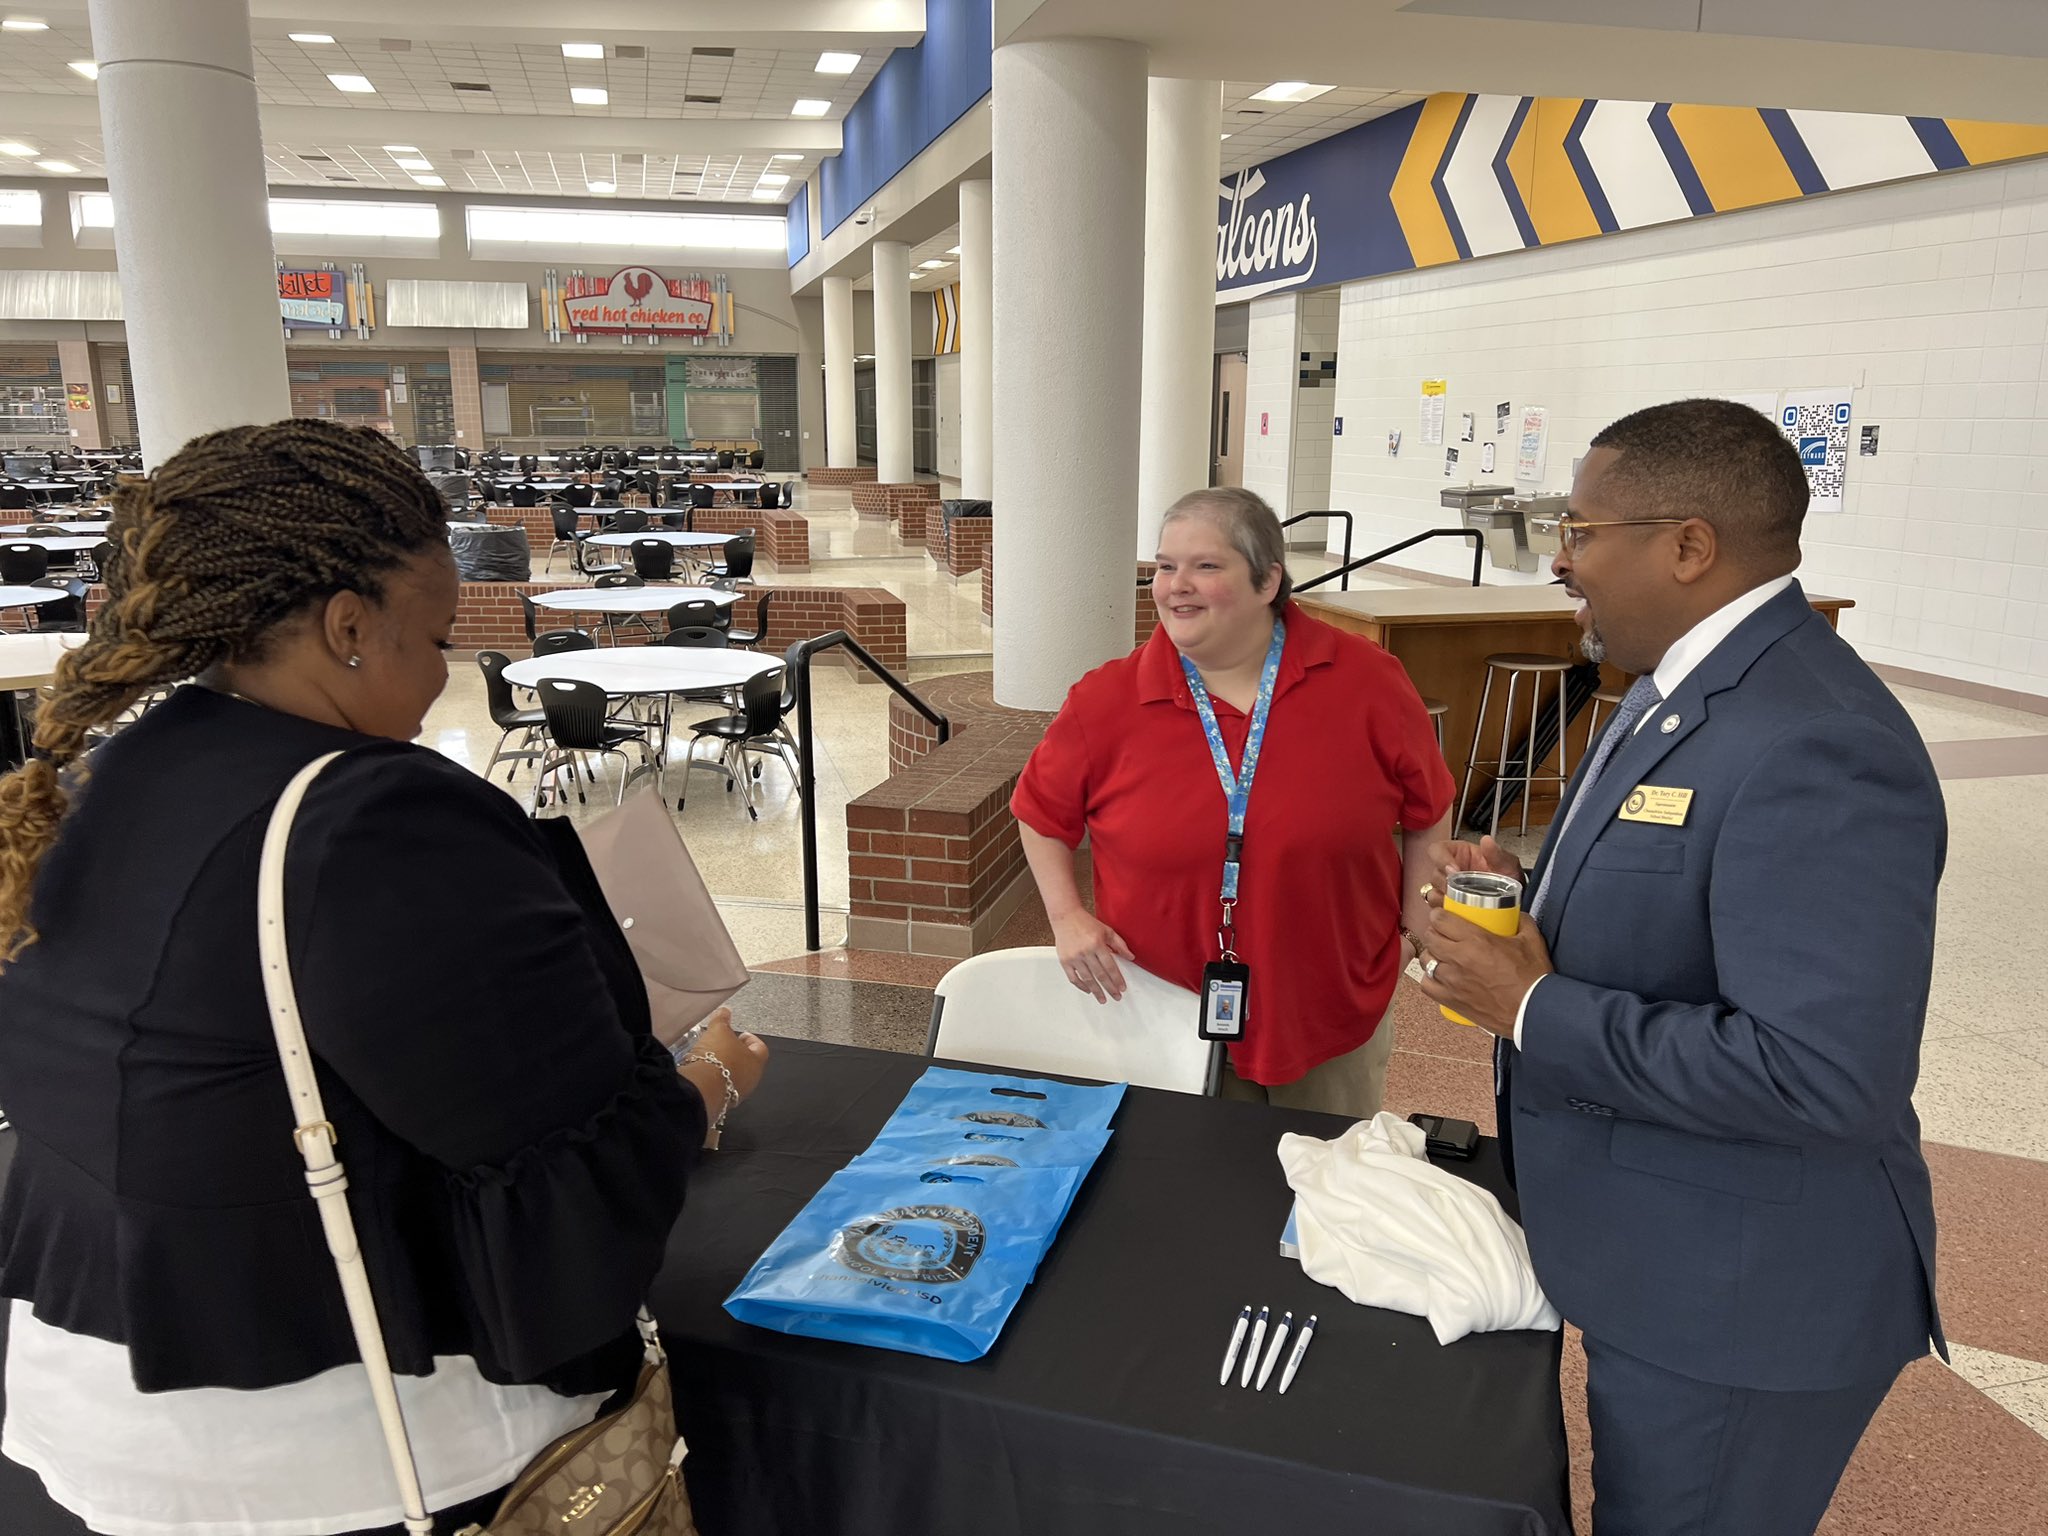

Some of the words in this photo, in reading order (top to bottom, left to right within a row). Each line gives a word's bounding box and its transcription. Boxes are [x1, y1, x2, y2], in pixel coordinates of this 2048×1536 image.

[572, 305, 599, 322] red
[602, 305, 627, 322] hot
[630, 307, 685, 324] chicken
[688, 311, 707, 324] co.
[561, 1482, 606, 1523] COACH
